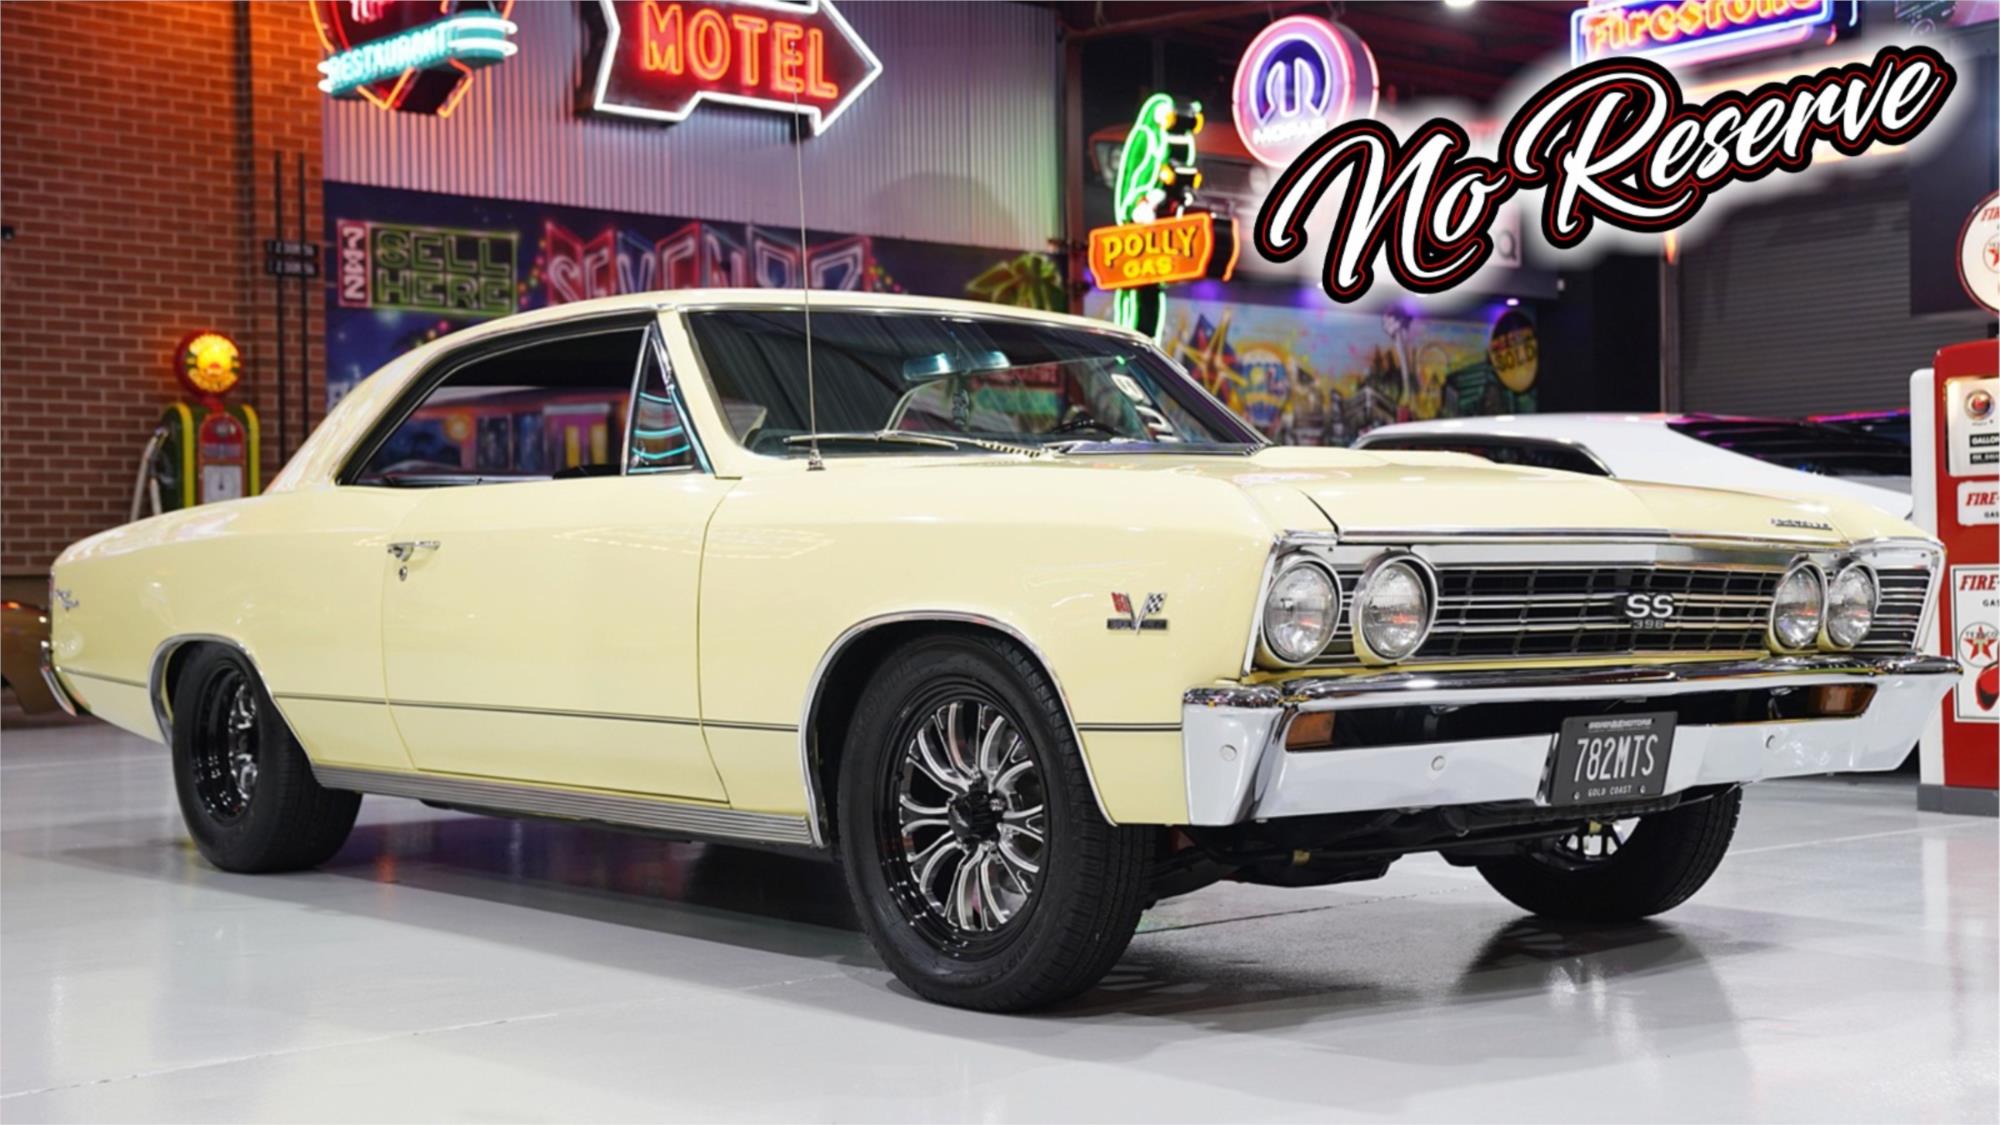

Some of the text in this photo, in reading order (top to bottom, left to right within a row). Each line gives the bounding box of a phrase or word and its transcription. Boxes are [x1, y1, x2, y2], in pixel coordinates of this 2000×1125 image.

[329, 20, 449, 84] RESTAURANT
[641, 2, 839, 98] MOTEL
[1252, 118, 1327, 147] MOPAR
[376, 230, 510, 277] SELL
[1102, 224, 1197, 268] POLLY
[1123, 256, 1173, 279] GAS
[377, 268, 511, 312] HERE
[1625, 593, 1674, 619] SS
[1574, 734, 1659, 783] 782MTS
[1587, 784, 1632, 798] GOLD COAST
